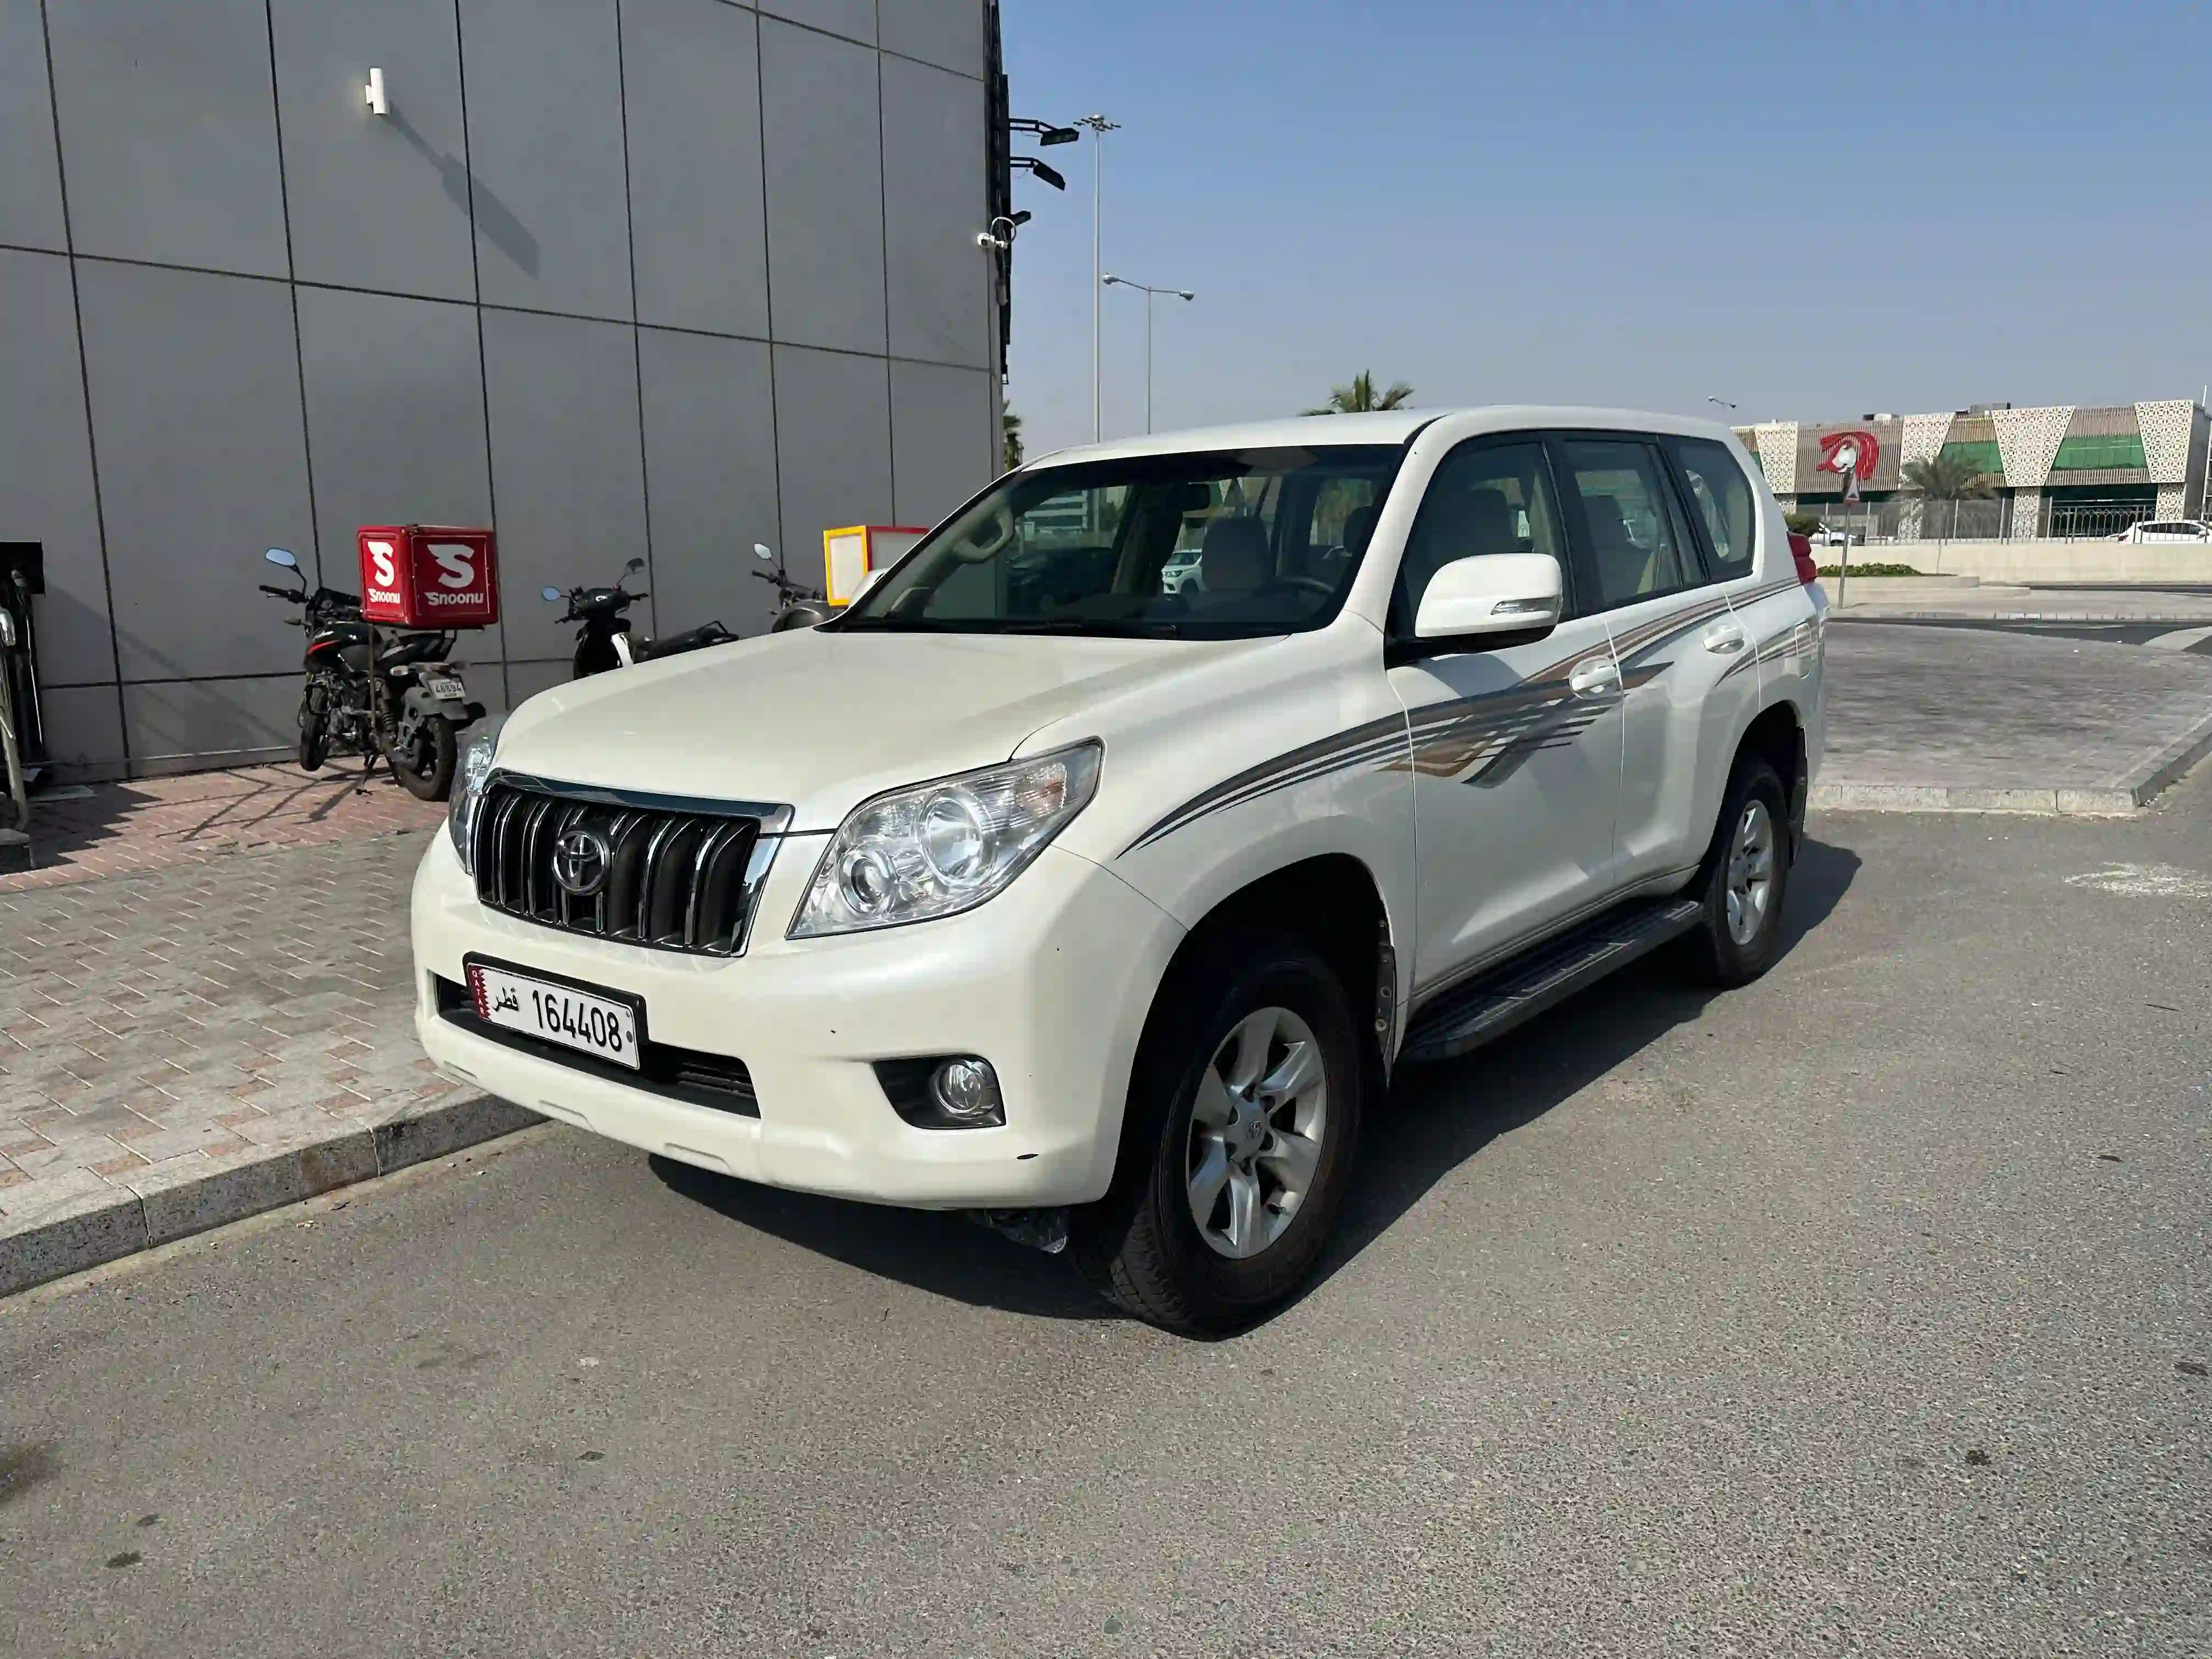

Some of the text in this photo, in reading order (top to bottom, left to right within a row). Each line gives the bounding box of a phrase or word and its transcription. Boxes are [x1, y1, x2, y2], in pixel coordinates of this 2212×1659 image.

[368, 588, 400, 604] Snoonu
[424, 591, 484, 606] Snoonu
[472, 970, 485, 1015] QATAR
[492, 986, 519, 1012] قطر
[532, 990, 622, 1052] 164408
